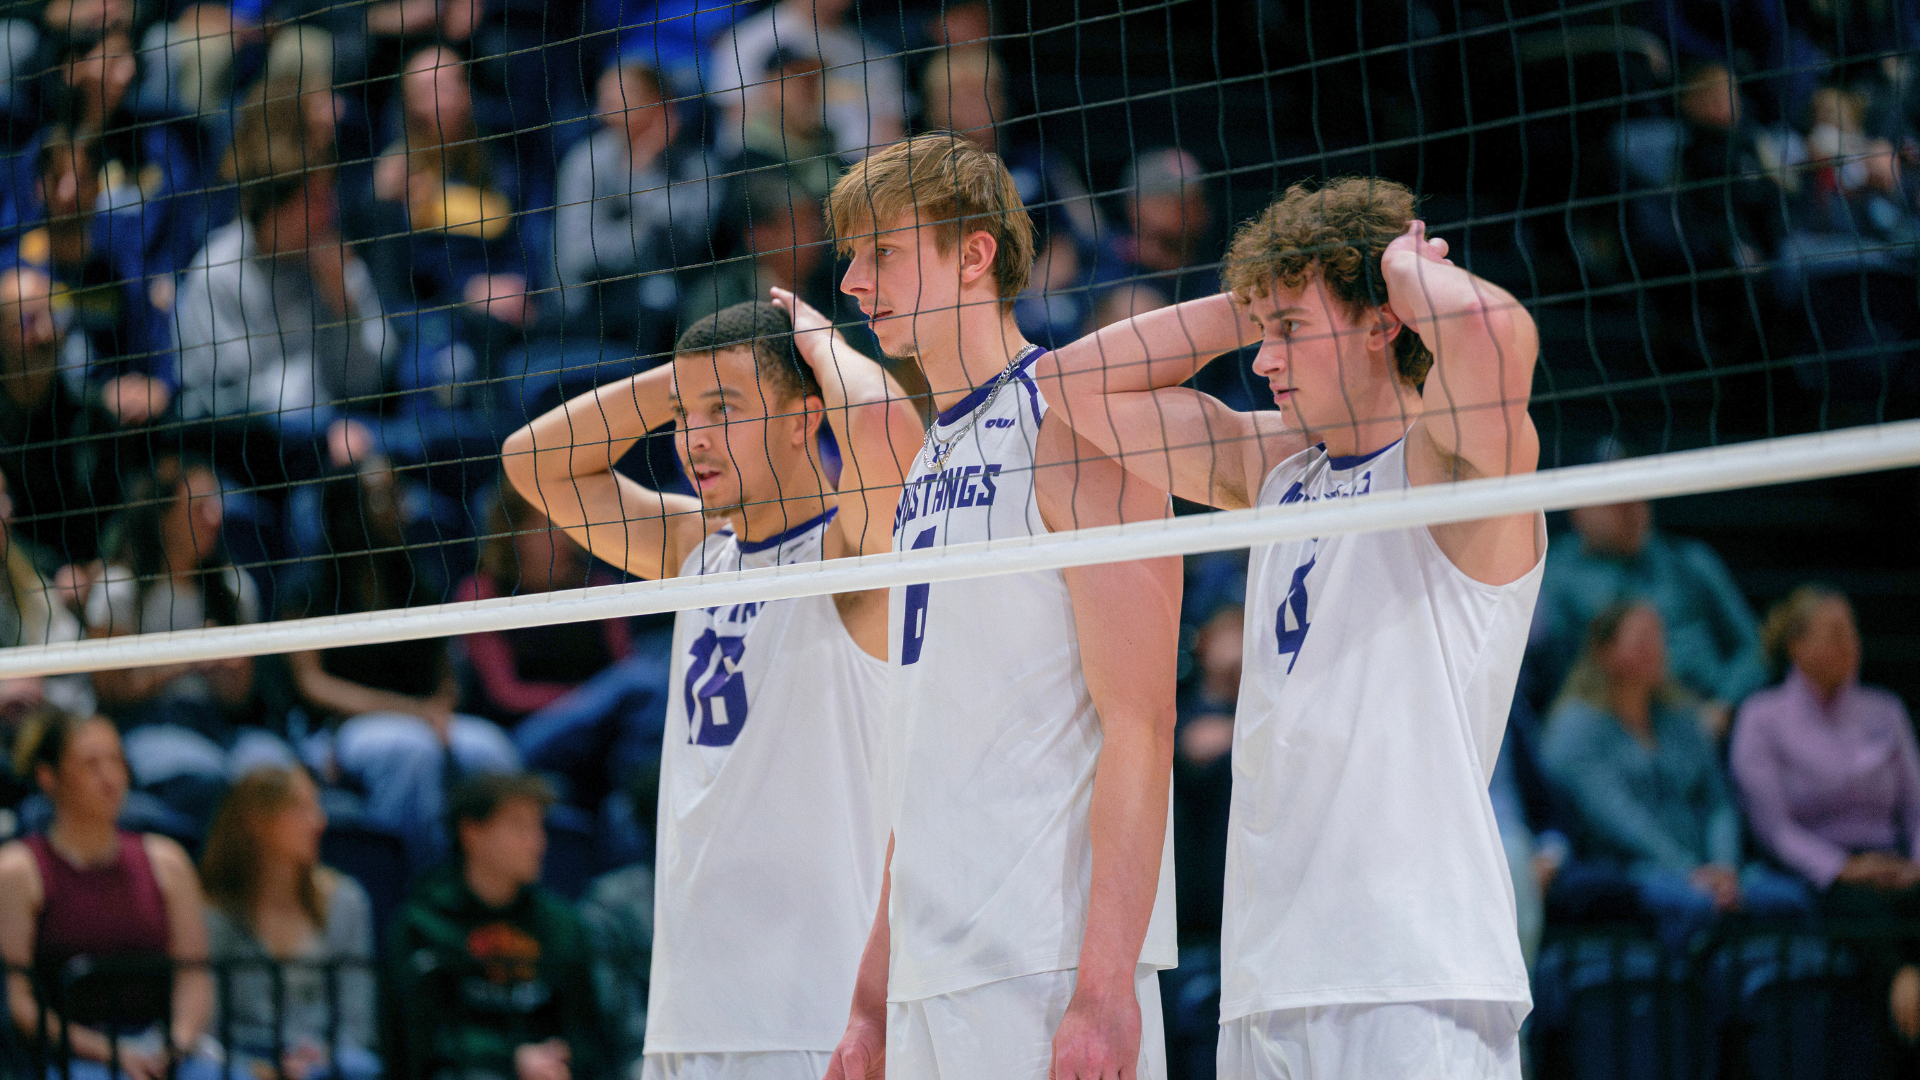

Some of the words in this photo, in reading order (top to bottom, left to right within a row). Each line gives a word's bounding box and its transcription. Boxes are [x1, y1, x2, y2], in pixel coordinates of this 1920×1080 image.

[985, 418, 1016, 428] OUA
[1275, 552, 1316, 675] 4
[684, 627, 748, 747] 16
